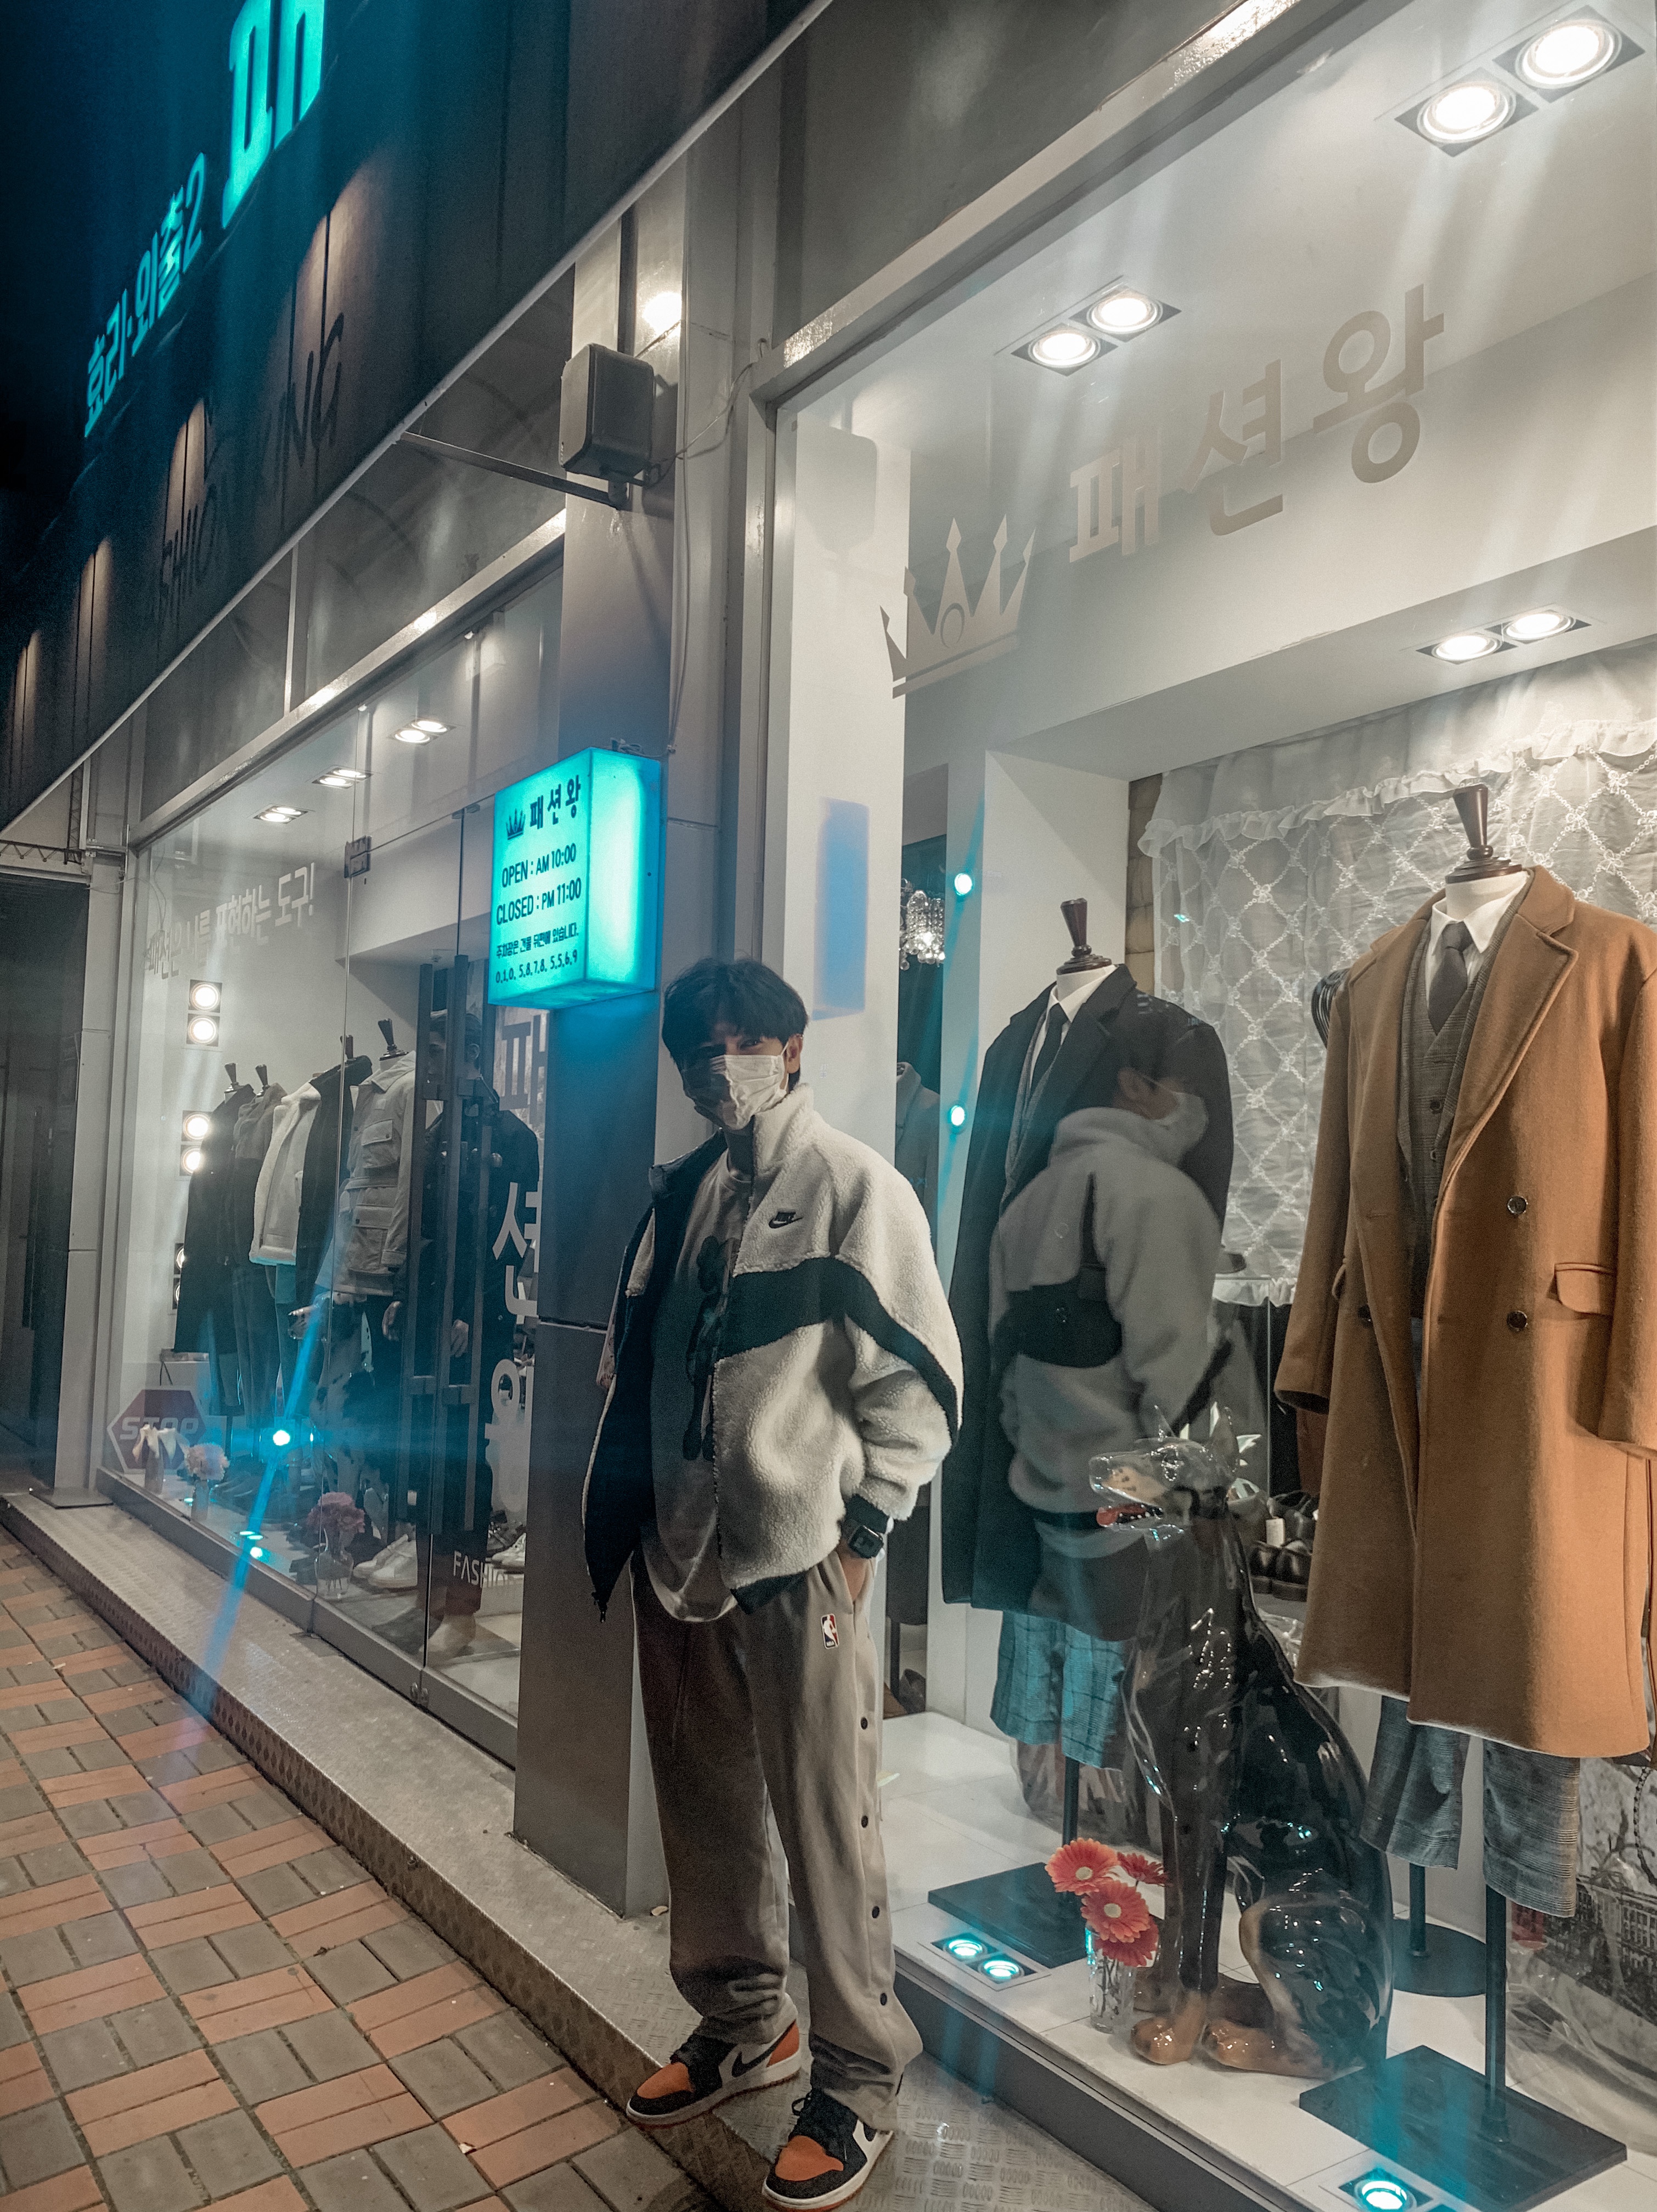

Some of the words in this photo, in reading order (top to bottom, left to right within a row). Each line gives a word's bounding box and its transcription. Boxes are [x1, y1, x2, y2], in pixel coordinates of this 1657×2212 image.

[1069, 283, 1444, 563] 패션왕
[529, 774, 581, 830] 패션왕
[501, 859, 528, 888] OPEN
[536, 854, 549, 876] AM
[551, 843, 576, 869] 10:00
[275, 862, 314, 928] 도구!
[496, 895, 534, 926] CLOSED
[542, 889, 555, 910] PM
[557, 877, 582, 905] 11:00
[520, 935, 532, 953] 건물
